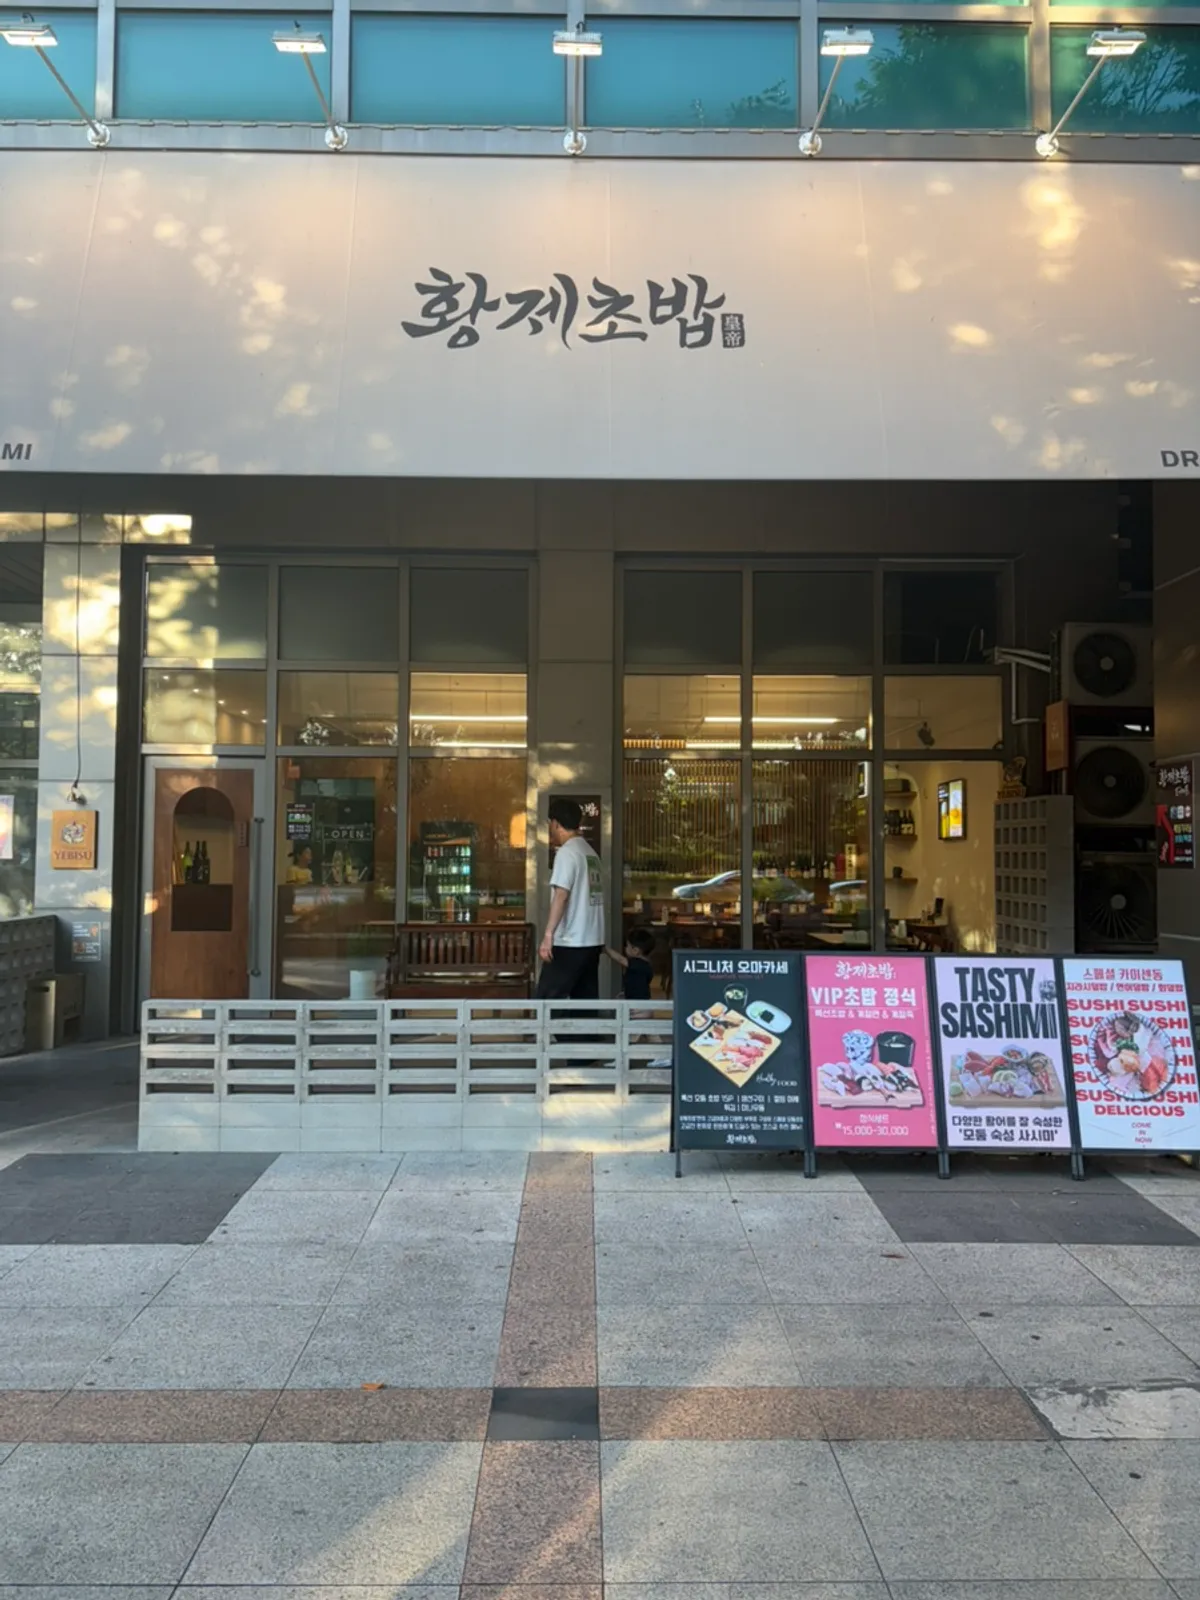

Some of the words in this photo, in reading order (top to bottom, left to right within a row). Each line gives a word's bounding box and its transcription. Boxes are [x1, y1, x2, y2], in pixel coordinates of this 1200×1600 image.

[401, 267, 726, 350] 황제초밥
[331, 830, 364, 838] OPEN
[54, 851, 92, 860] YEBISU
[683, 960, 734, 973] 시그니처
[737, 961, 788, 974] 오마카세
[1083, 968, 1115, 980] 스페셜
[954, 967, 1035, 1002] TASTY
[811, 987, 876, 1006] VIP초밥
[884, 987, 916, 1006] 정식
[1067, 999, 1124, 1010] SUSHI
[1127, 1000, 1185, 1011] SUSHI
[941, 1002, 1058, 1039] SASHIMI
[1095, 1105, 1185, 1117] DELICIOUS
[952, 1116, 982, 1126] 다양한
[991, 1129, 1015, 1141] 숙성
